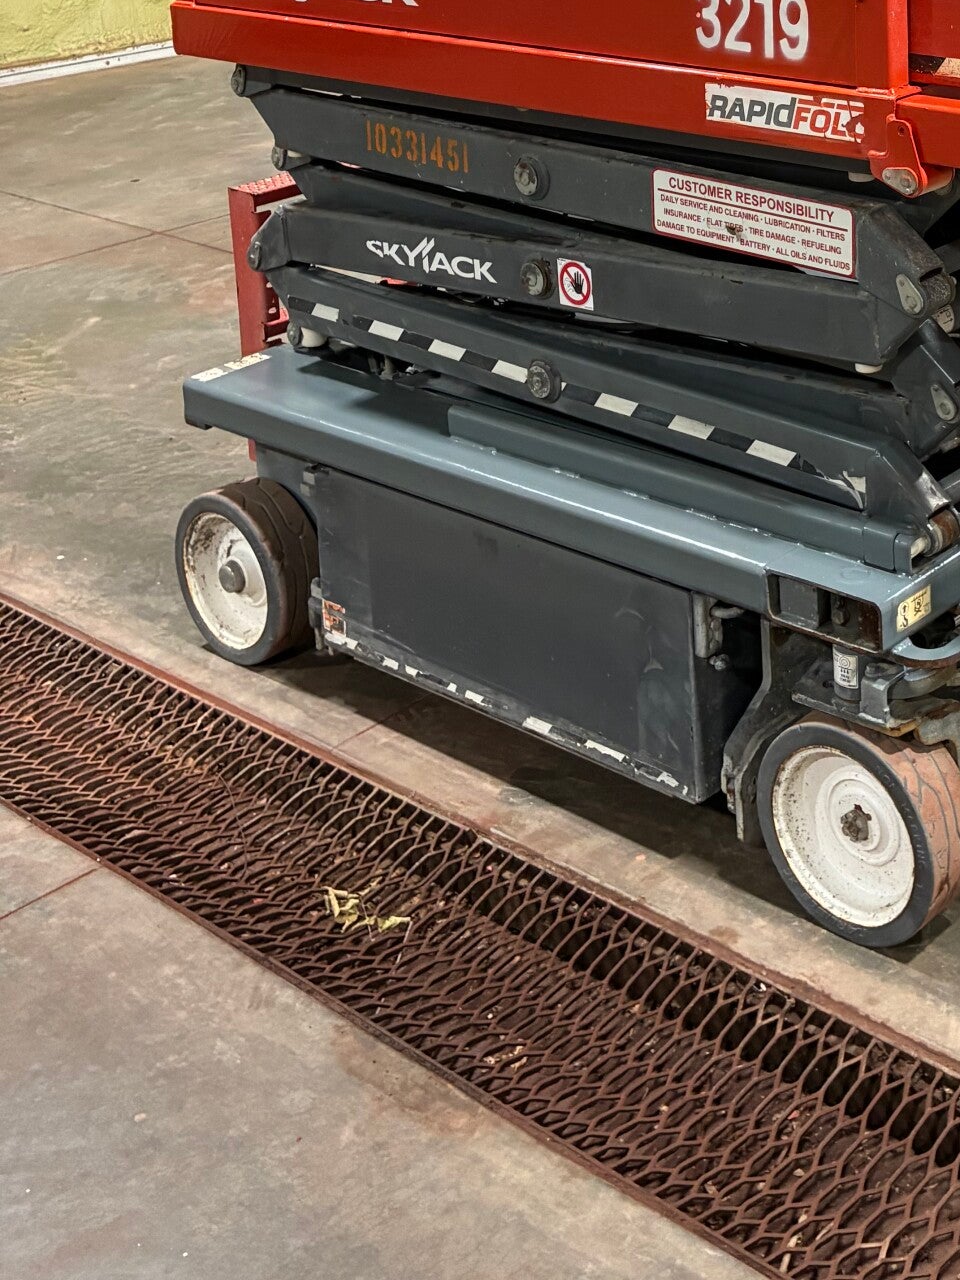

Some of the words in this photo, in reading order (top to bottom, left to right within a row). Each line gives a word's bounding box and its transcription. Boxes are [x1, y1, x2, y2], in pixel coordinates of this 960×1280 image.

[366, 120, 469, 173] 10331451
[661, 194, 679, 205] DAILY
[680, 198, 708, 211] SERVICE
[709, 205, 723, 214] AND
[724, 209, 759, 222] CLEANING
[765, 217, 810, 233] LUBRICATION
[816, 229, 845, 241] FILTERS
[669, 177, 732, 201] CUSTOMER
[736, 191, 834, 222] RESPONSIBILITY
[657, 219, 685, 231] DAMAGE
[686, 225, 695, 234] TO
[697, 228, 734, 243] EQUIPMENT
[740, 238, 771, 252] BATTERY
[776, 247, 789, 256] ALL
[791, 251, 807, 260] OILS
[808, 255, 823, 264] AND
[824, 259, 851, 270] FLUIDS
[664, 208, 701, 222] INSURANCE
[706, 218, 723, 227] FLAT
[749, 227, 764, 237] TIRE
[766, 231, 796, 244] DAMAGE
[802, 239, 842, 254] REFUELING
